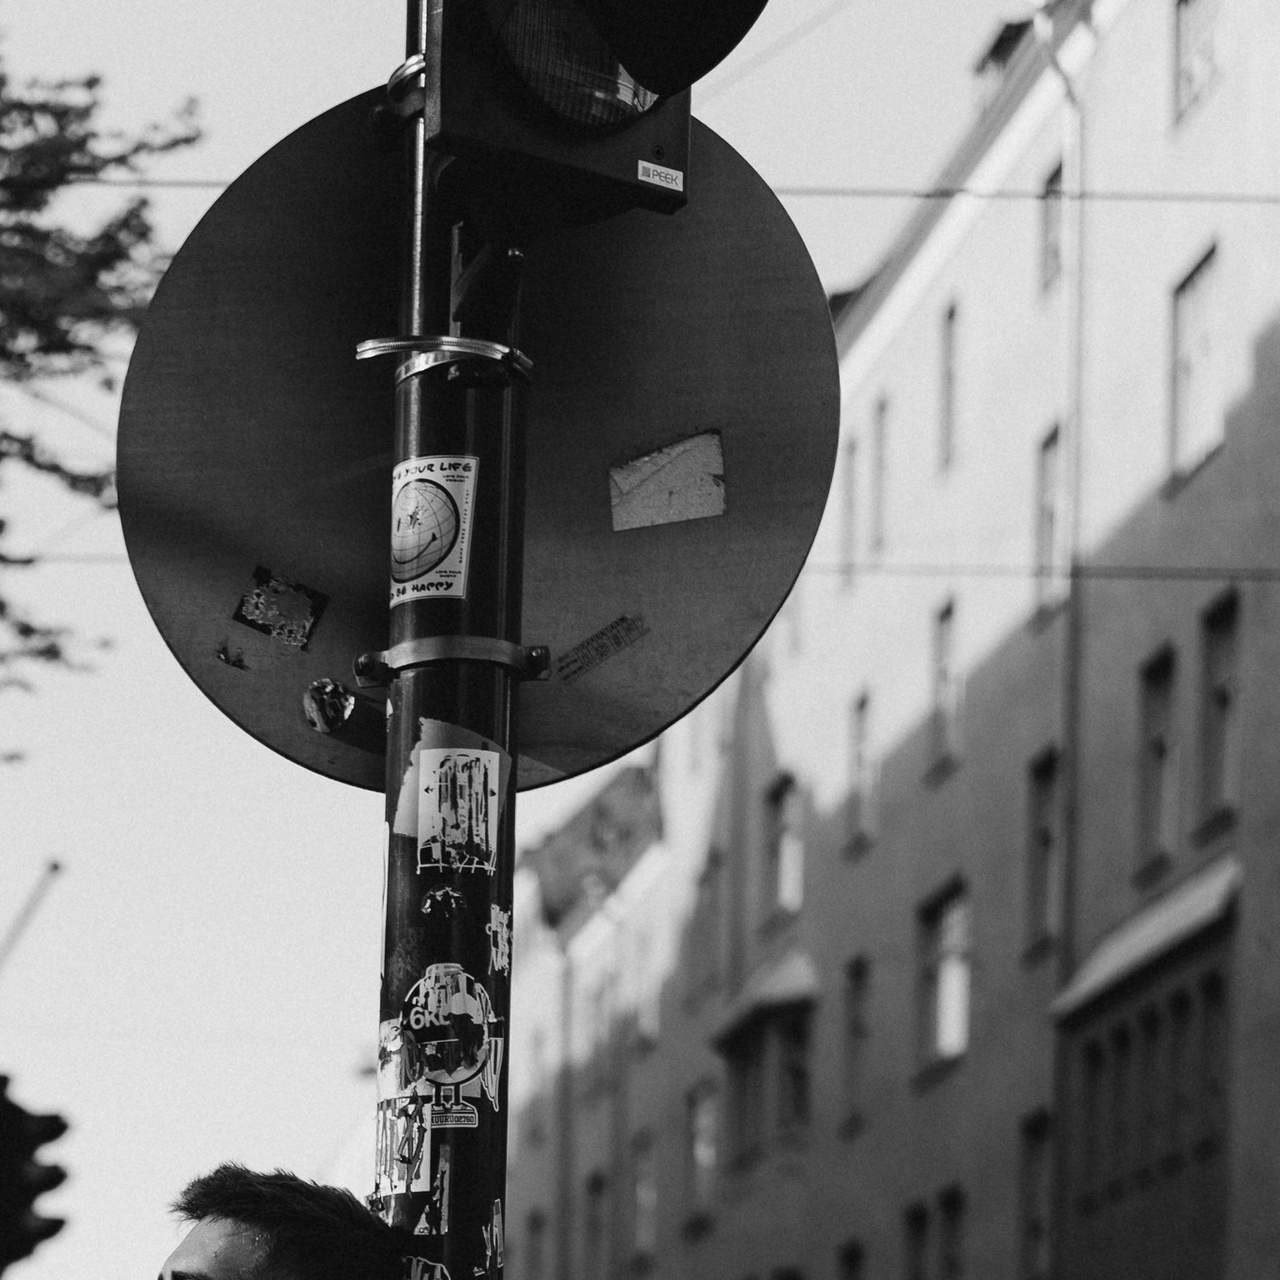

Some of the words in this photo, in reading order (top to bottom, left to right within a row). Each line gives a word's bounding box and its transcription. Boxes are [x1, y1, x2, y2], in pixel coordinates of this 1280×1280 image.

[652, 169, 679, 187] PEEK
[404, 462, 435, 477] YOUR
[439, 462, 472, 473] LIFE
[411, 581, 454, 593] HAPPY
